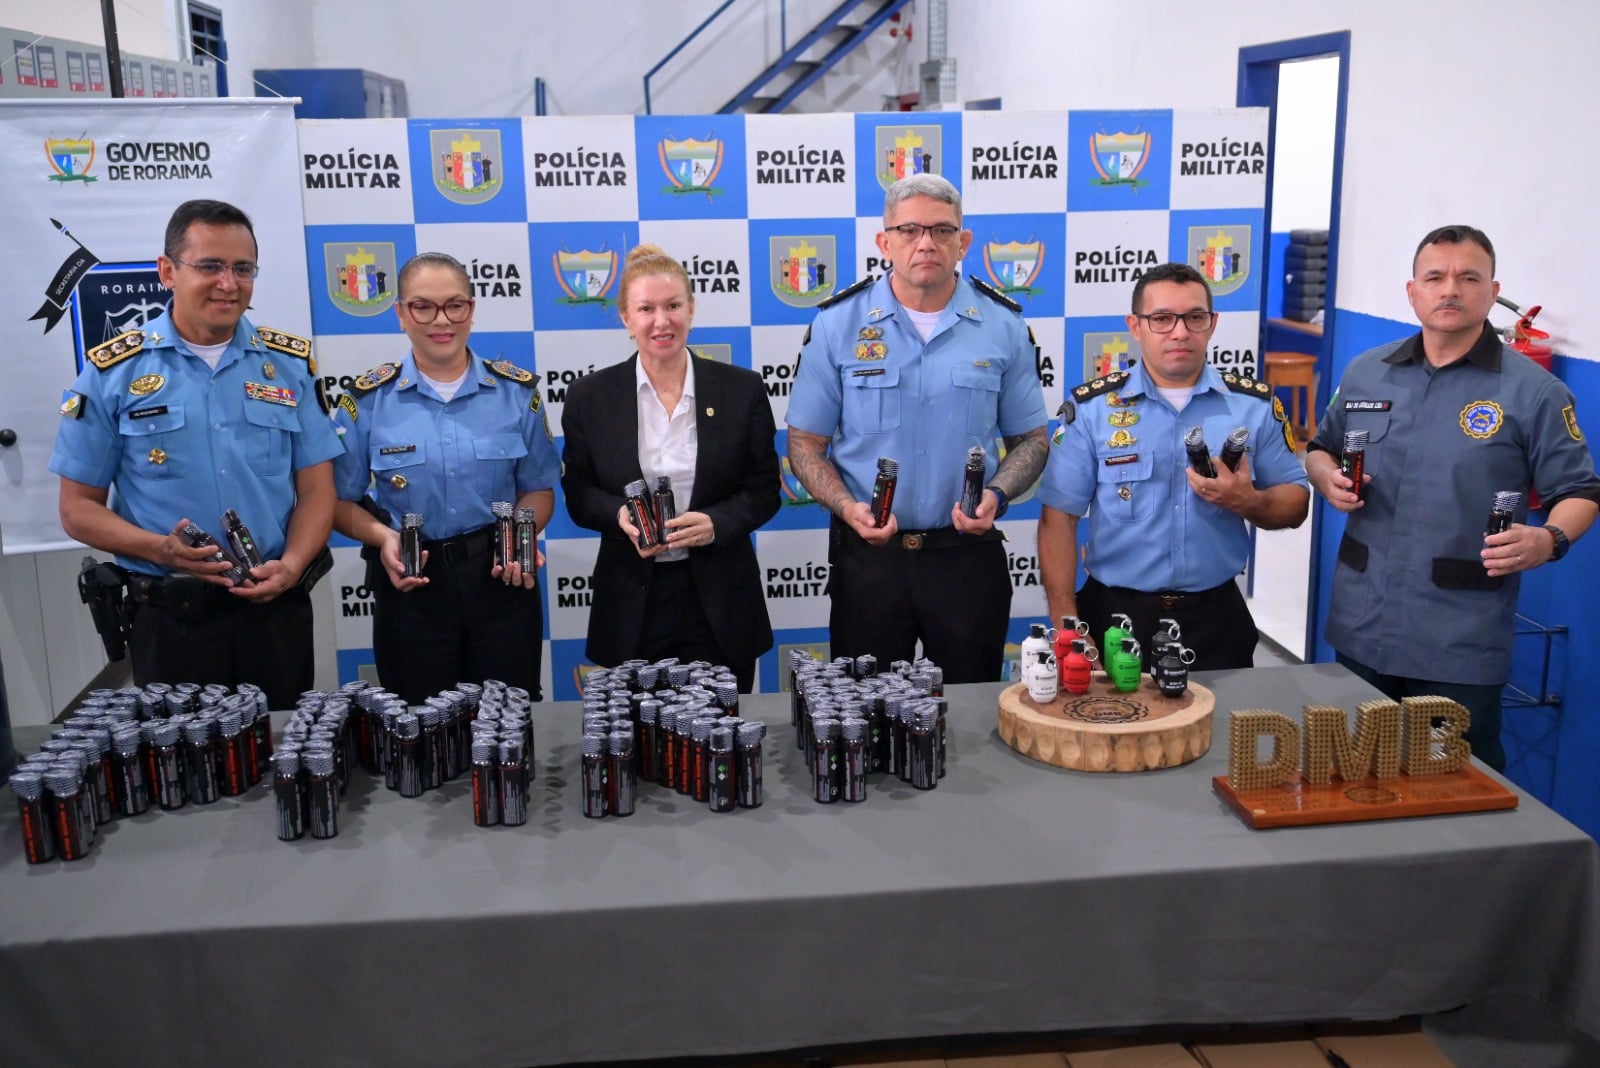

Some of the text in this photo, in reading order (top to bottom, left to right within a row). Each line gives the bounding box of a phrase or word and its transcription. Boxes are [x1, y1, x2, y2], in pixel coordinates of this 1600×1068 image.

[106, 141, 210, 162] GOVERNO
[534, 146, 626, 169] POLÍCIA
[756, 144, 845, 166] POLÍCIA
[972, 141, 1058, 162] POLÍCIA
[1181, 137, 1265, 159] POLÍCIA
[304, 148, 399, 172] POLÍCIA
[1180, 159, 1265, 176] MILITAR
[108, 163, 212, 181] DE RORAIMA
[305, 172, 400, 189] MILITAR
[534, 170, 627, 187] MILITAR
[756, 167, 846, 184] MILITAR
[971, 163, 1058, 181] MILITAR
[1075, 245, 1158, 266] POLÍCIA
[55, 258, 86, 296] SECRETARIA DA
[463, 258, 521, 280] ÍCIA
[1074, 267, 1144, 284] MILITA
[101, 282, 169, 295] RORAIM
[471, 281, 522, 298] ITAR
[690, 277, 740, 293] ITAR
[1207, 345, 1255, 365] ÍCIA
[766, 561, 828, 582] POLÍC
[766, 583, 828, 599] MILIT
[1229, 695, 1471, 791] DMB
